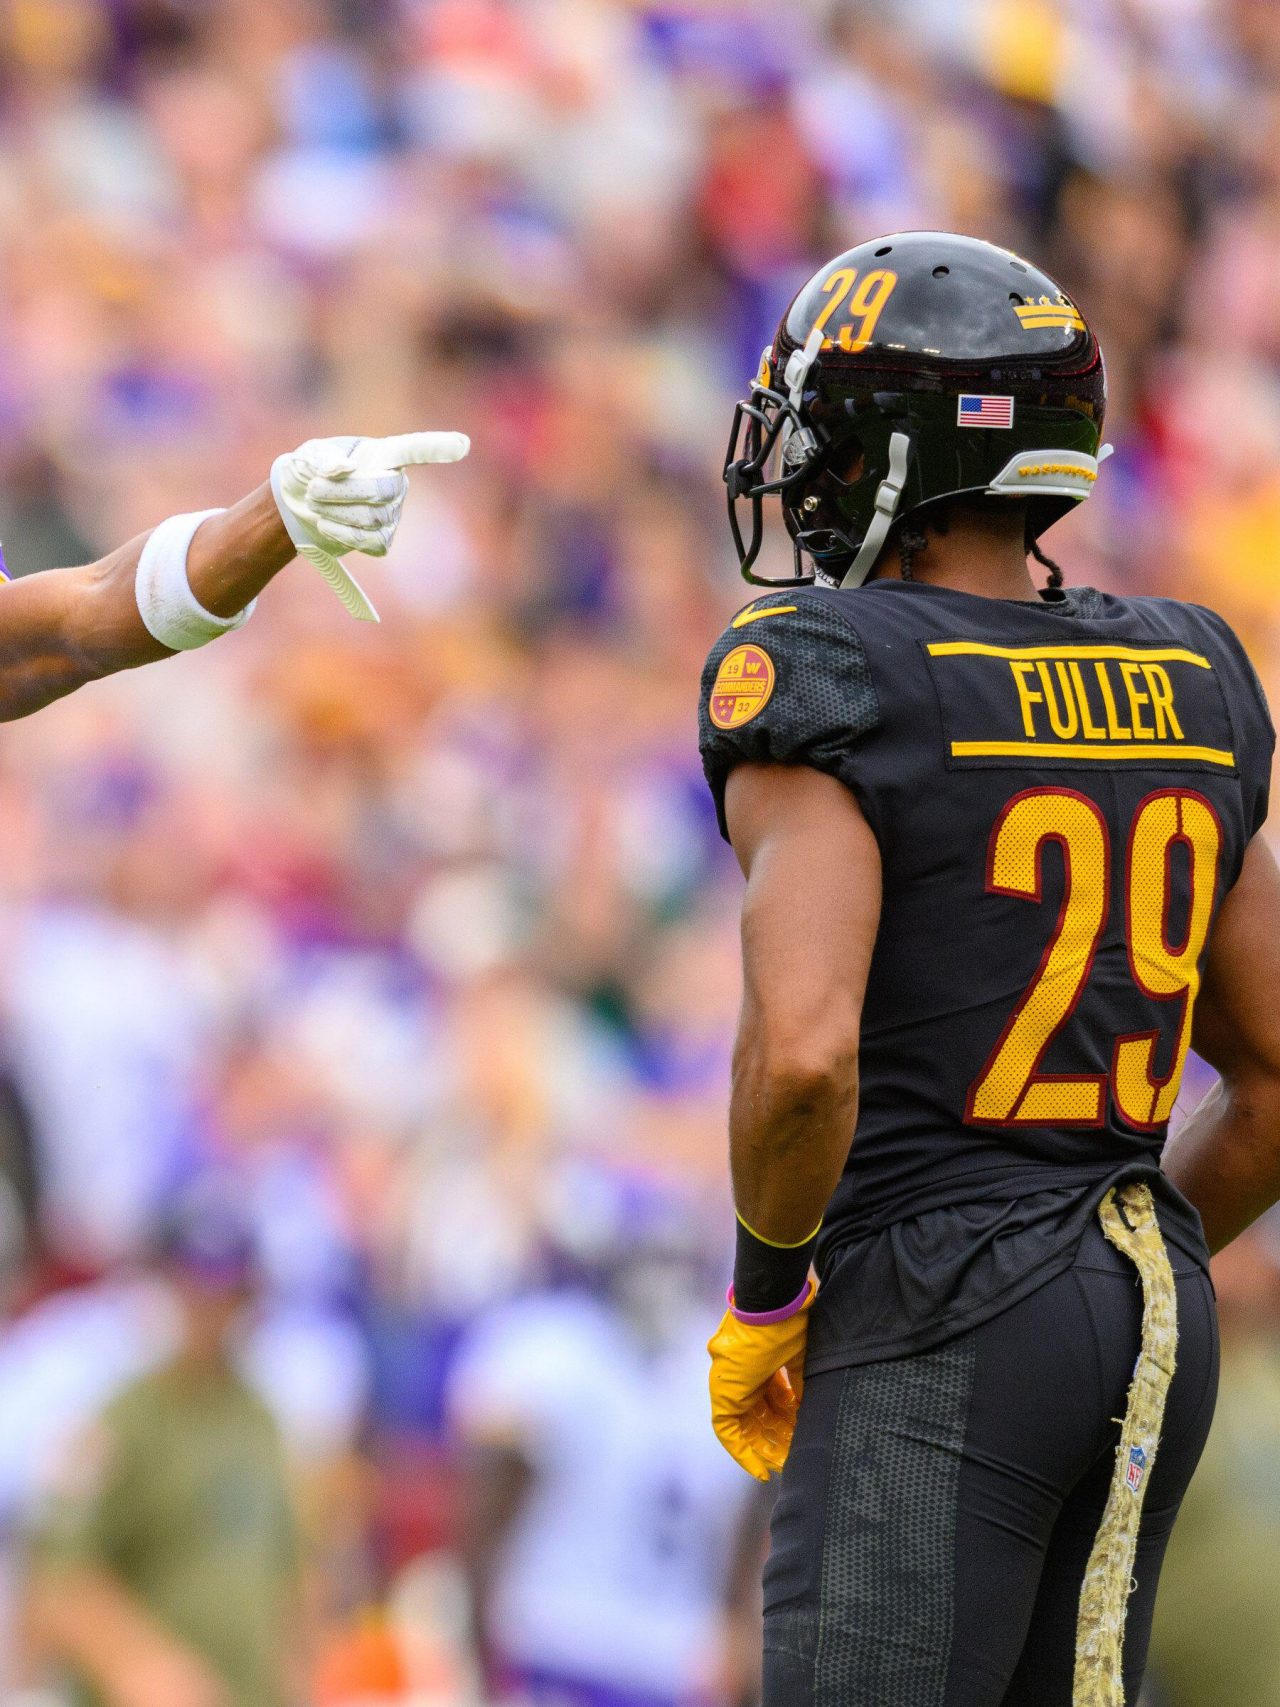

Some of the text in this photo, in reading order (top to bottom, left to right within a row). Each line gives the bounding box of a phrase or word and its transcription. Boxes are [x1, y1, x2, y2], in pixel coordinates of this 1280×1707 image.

[804, 267, 899, 354] 29
[727, 665, 739, 674] 19
[738, 703, 750, 712] 32
[1009, 661, 1185, 740] FULLER
[963, 785, 1224, 1131] 29
